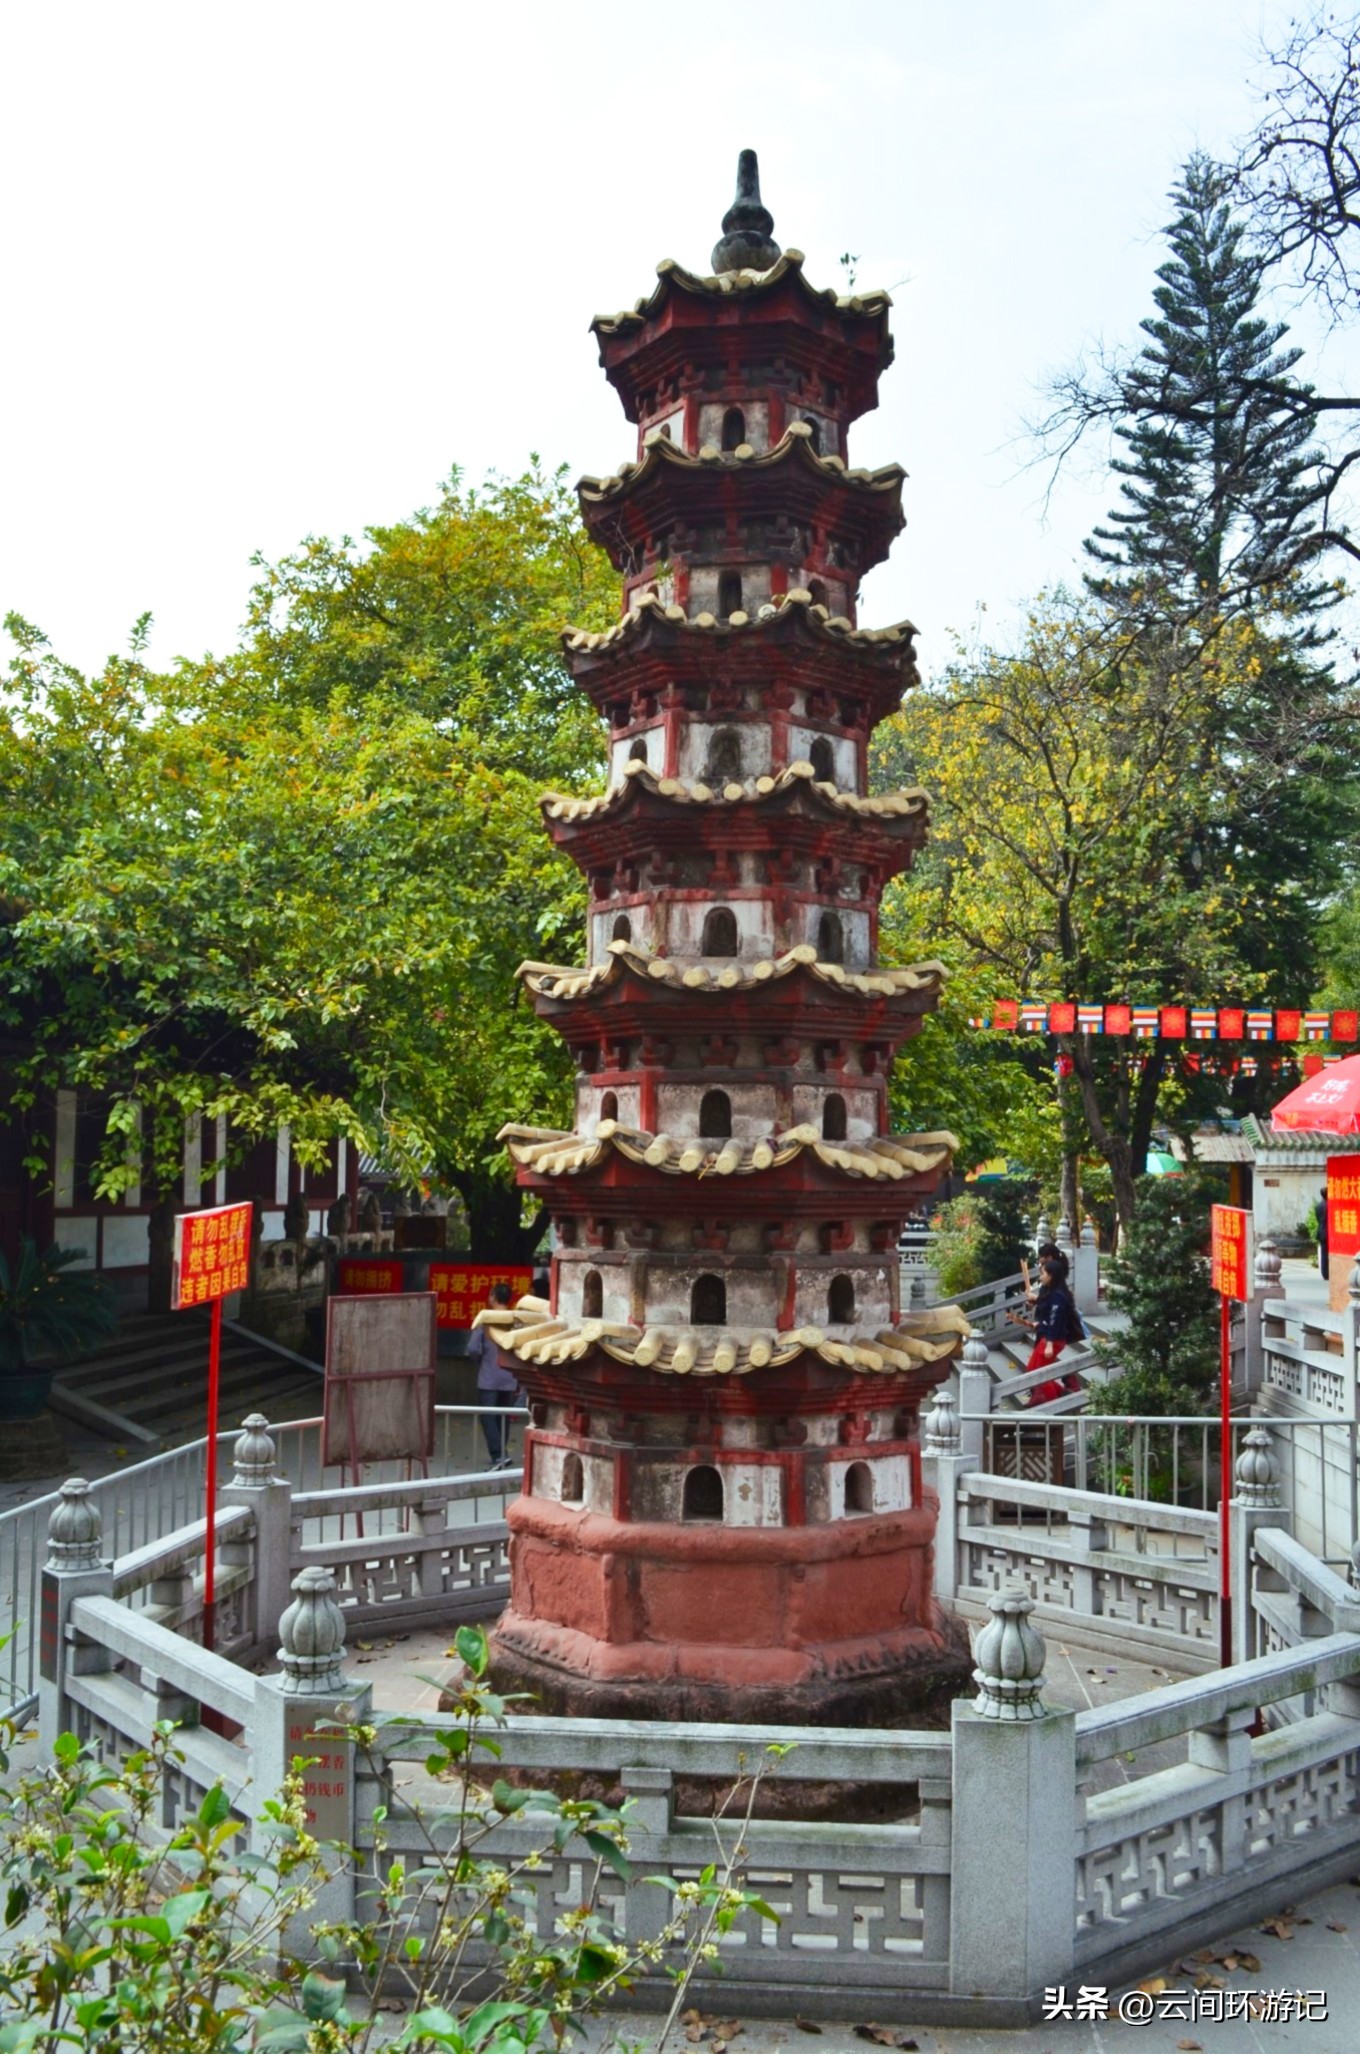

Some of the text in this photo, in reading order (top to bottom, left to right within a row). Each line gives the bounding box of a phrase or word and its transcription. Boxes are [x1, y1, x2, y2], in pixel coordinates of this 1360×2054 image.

[181, 1261, 247, 1303] 违者因果自负
